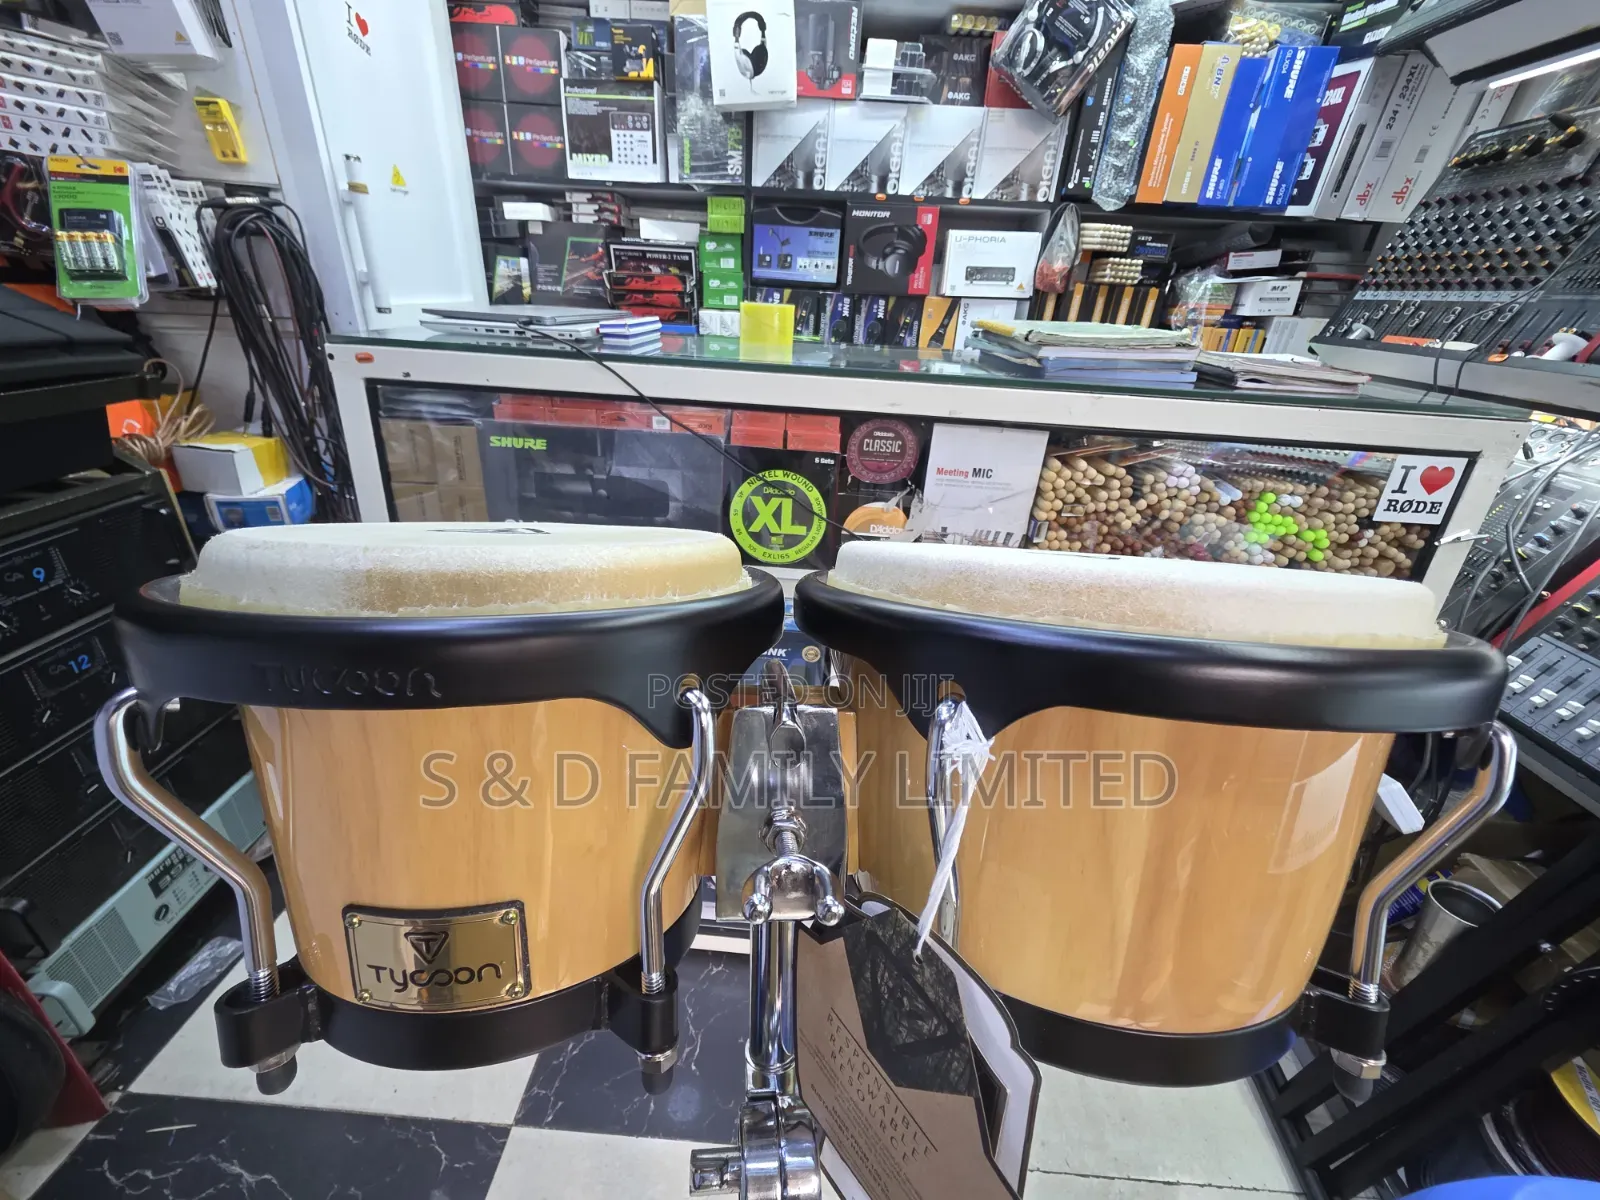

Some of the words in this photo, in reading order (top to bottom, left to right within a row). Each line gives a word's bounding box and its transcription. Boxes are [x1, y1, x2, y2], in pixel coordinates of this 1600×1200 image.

[1283, 48, 1307, 100] SHURE
[951, 91, 970, 100] AKG
[1385, 109, 1400, 131] 234
[1397, 61, 1421, 100] 234XL
[1205, 156, 1224, 199] SHURE
[1265, 160, 1285, 205] SHURE
[1390, 173, 1415, 207] dbx
[1354, 181, 1374, 208] dbx
[852, 209, 891, 219] MONITOR
[489, 435, 547, 450] SHURE
[863, 438, 902, 453] CLASSIC
[747, 469, 779, 488] NICKEL
[783, 470, 814, 493] WOUND
[936, 467, 969, 479] Meeting
[971, 467, 993, 479] MIC
[1391, 465, 1417, 494] I
[748, 495, 807, 536] XL
[1383, 498, 1443, 514] RØDE
[762, 550, 790, 560] EXL165
[32, 567, 45, 583] 9
[68, 654, 91, 674] 12
[762, 648, 787, 657] NK
[366, 963, 502, 993] Tycoon
[827, 1013, 932, 1161] RESPONSIBLE
[829, 1033, 918, 1162] RENEWABLE
[830, 1051, 911, 1163] RESOURCE
